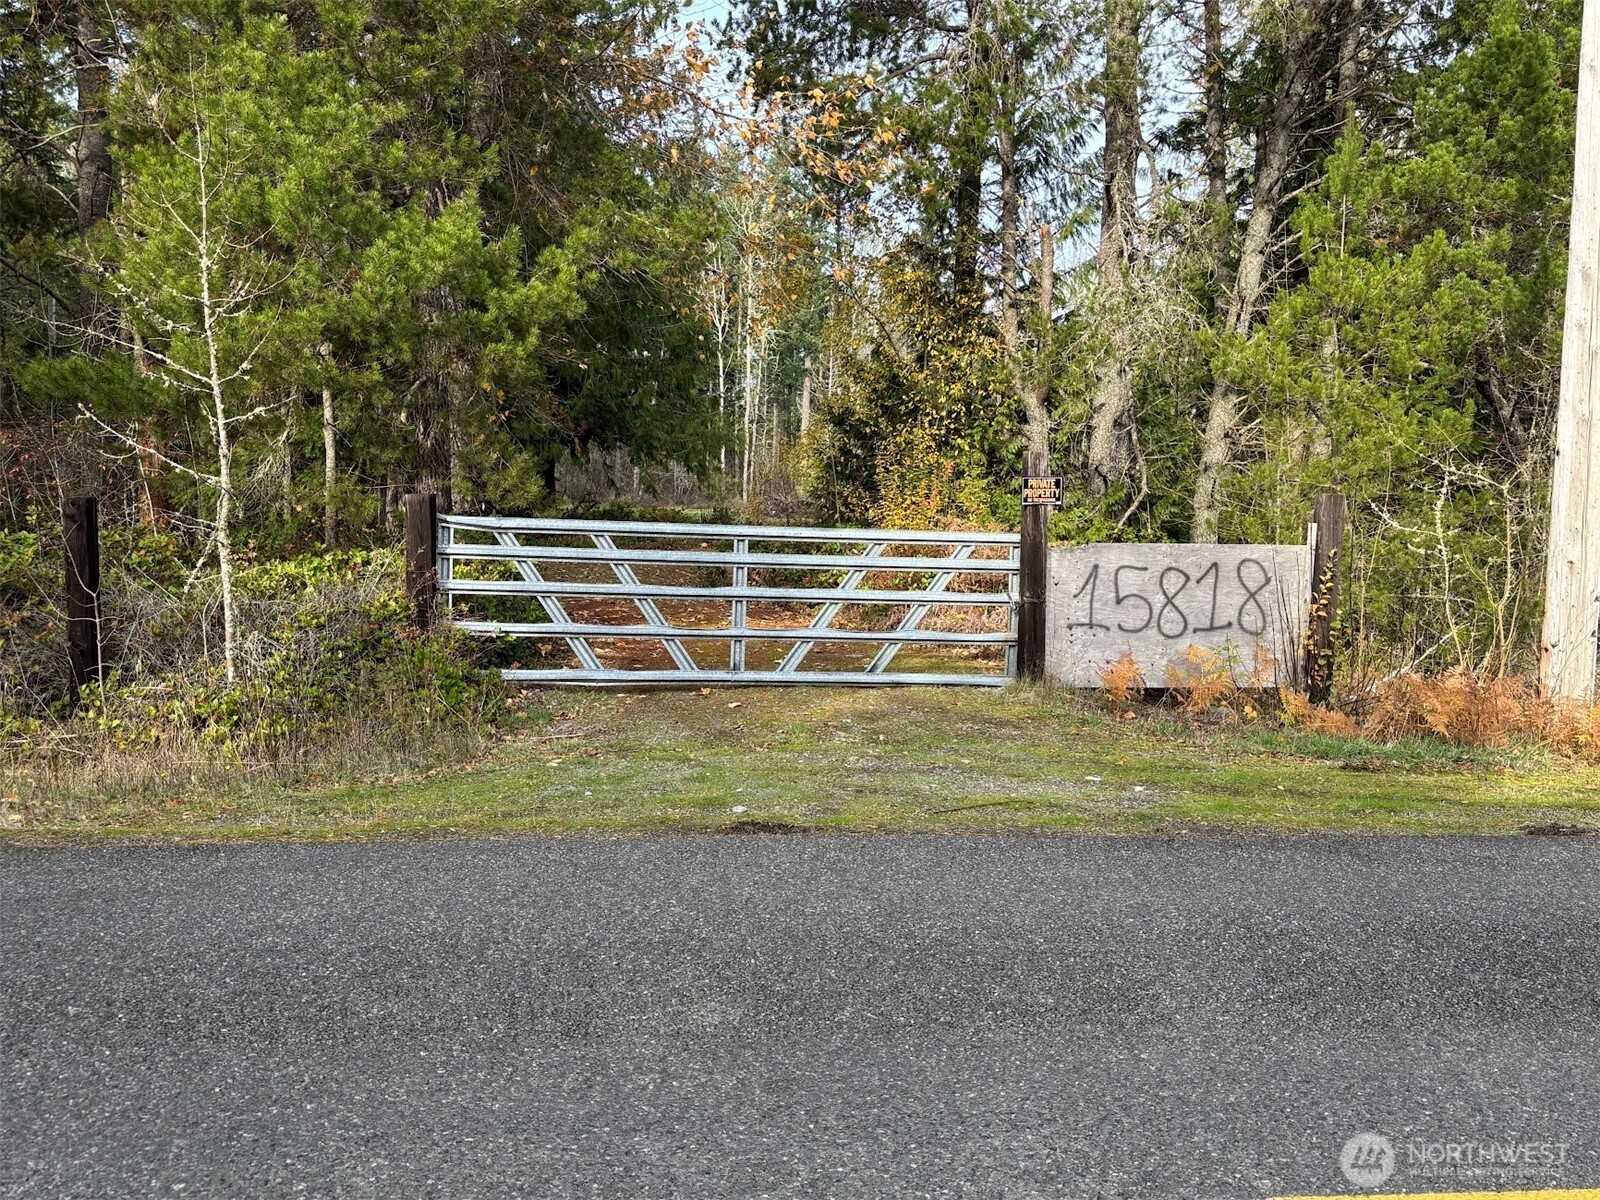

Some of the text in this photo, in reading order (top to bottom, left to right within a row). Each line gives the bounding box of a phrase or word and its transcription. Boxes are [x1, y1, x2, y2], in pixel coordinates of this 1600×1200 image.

[1028, 479, 1056, 488] PRIVATE
[1024, 488, 1060, 498] PROPERTY
[1066, 557, 1272, 639] 15818
